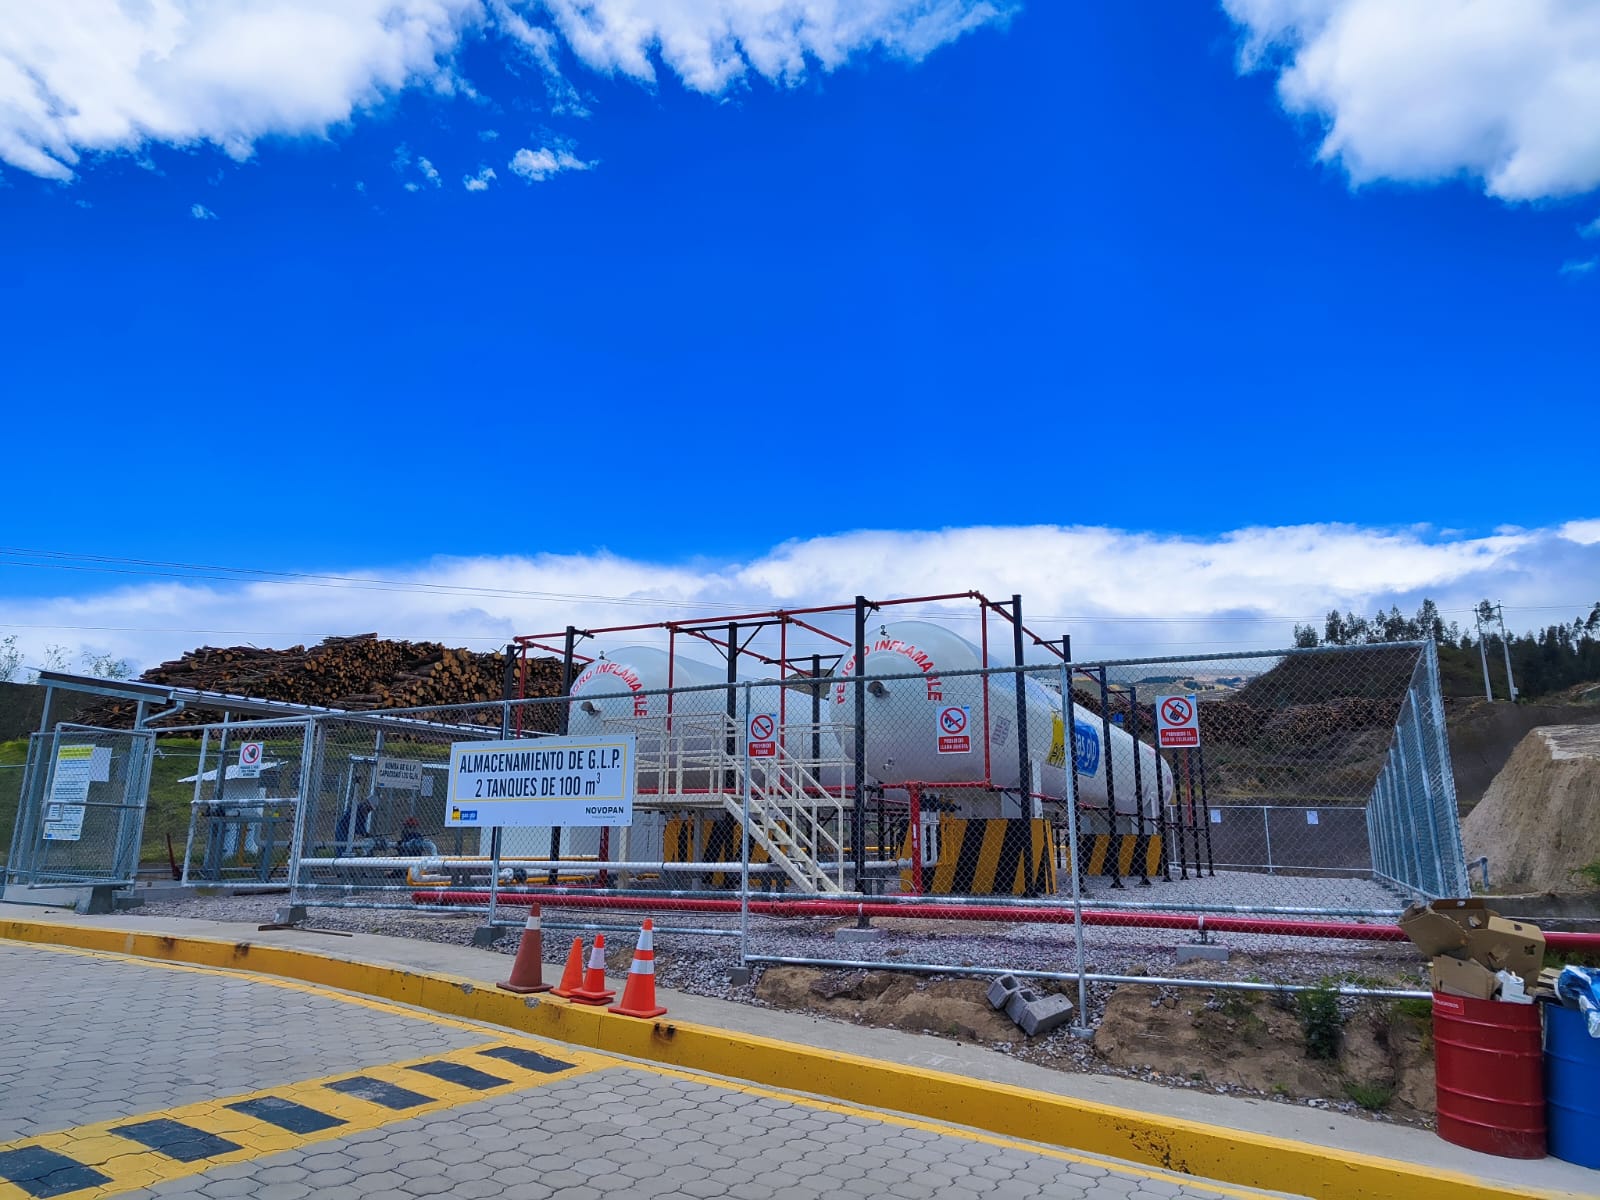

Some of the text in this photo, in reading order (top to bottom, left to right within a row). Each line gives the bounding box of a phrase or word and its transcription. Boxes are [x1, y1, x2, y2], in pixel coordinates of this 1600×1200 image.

[459, 748, 621, 773] ALMACENAMIENTO DE G.L.P.
[474, 778, 482, 798] 2
[486, 777, 538, 798] TANQUES
[541, 776, 556, 796] DE
[559, 776, 581, 796] 100
[585, 806, 624, 814] NOVOPAN
